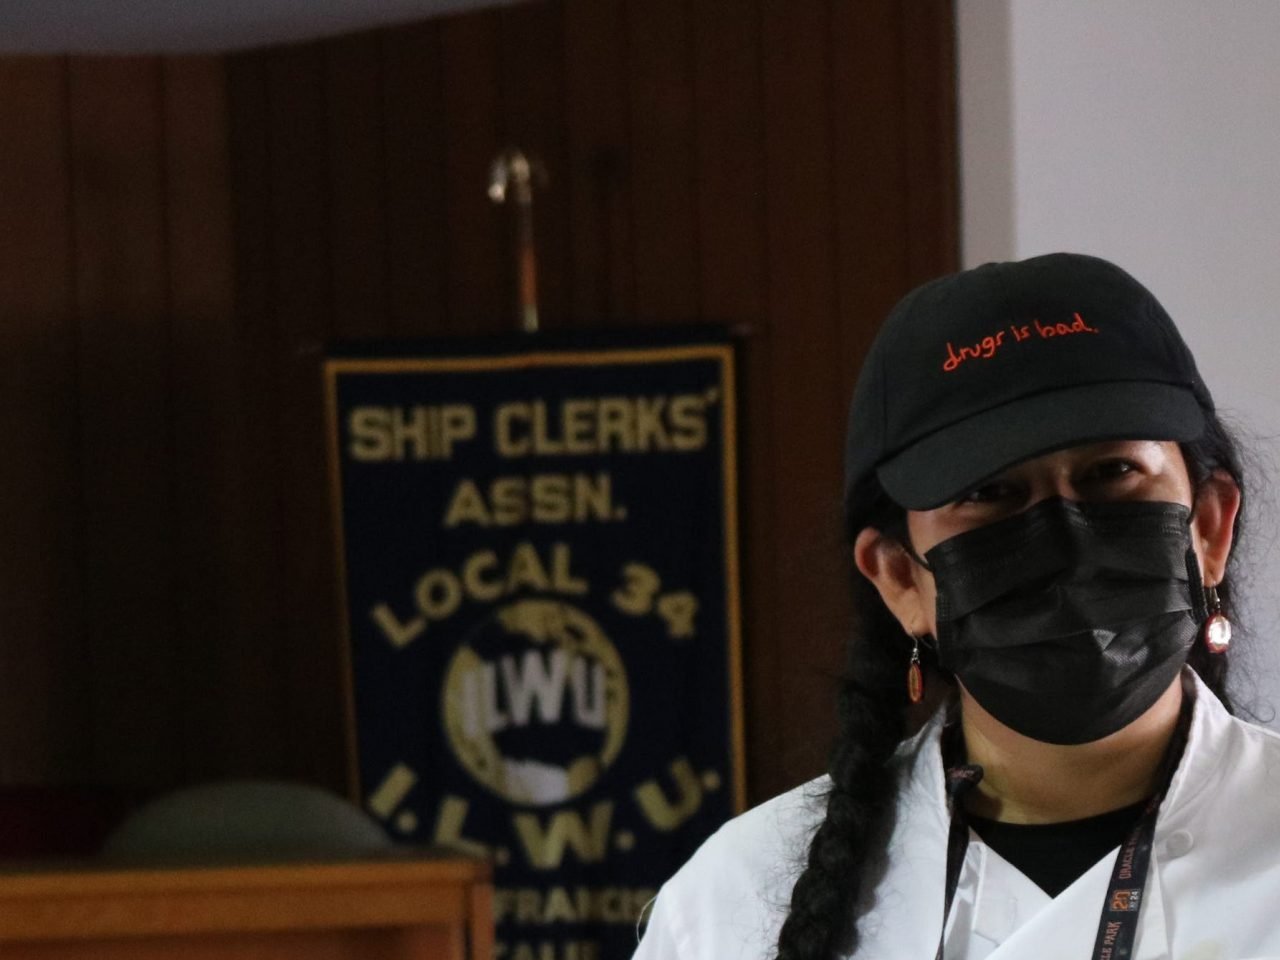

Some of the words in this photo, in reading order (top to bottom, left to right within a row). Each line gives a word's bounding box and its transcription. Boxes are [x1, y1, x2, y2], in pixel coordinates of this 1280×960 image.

[1034, 312, 1098, 338] bad.
[348, 403, 476, 462] SHIP
[495, 386, 718, 458] CLERKS'
[444, 474, 627, 528] ASSN.
[371, 542, 588, 648] LOCAL
[1104, 921, 1122, 945] PARK
